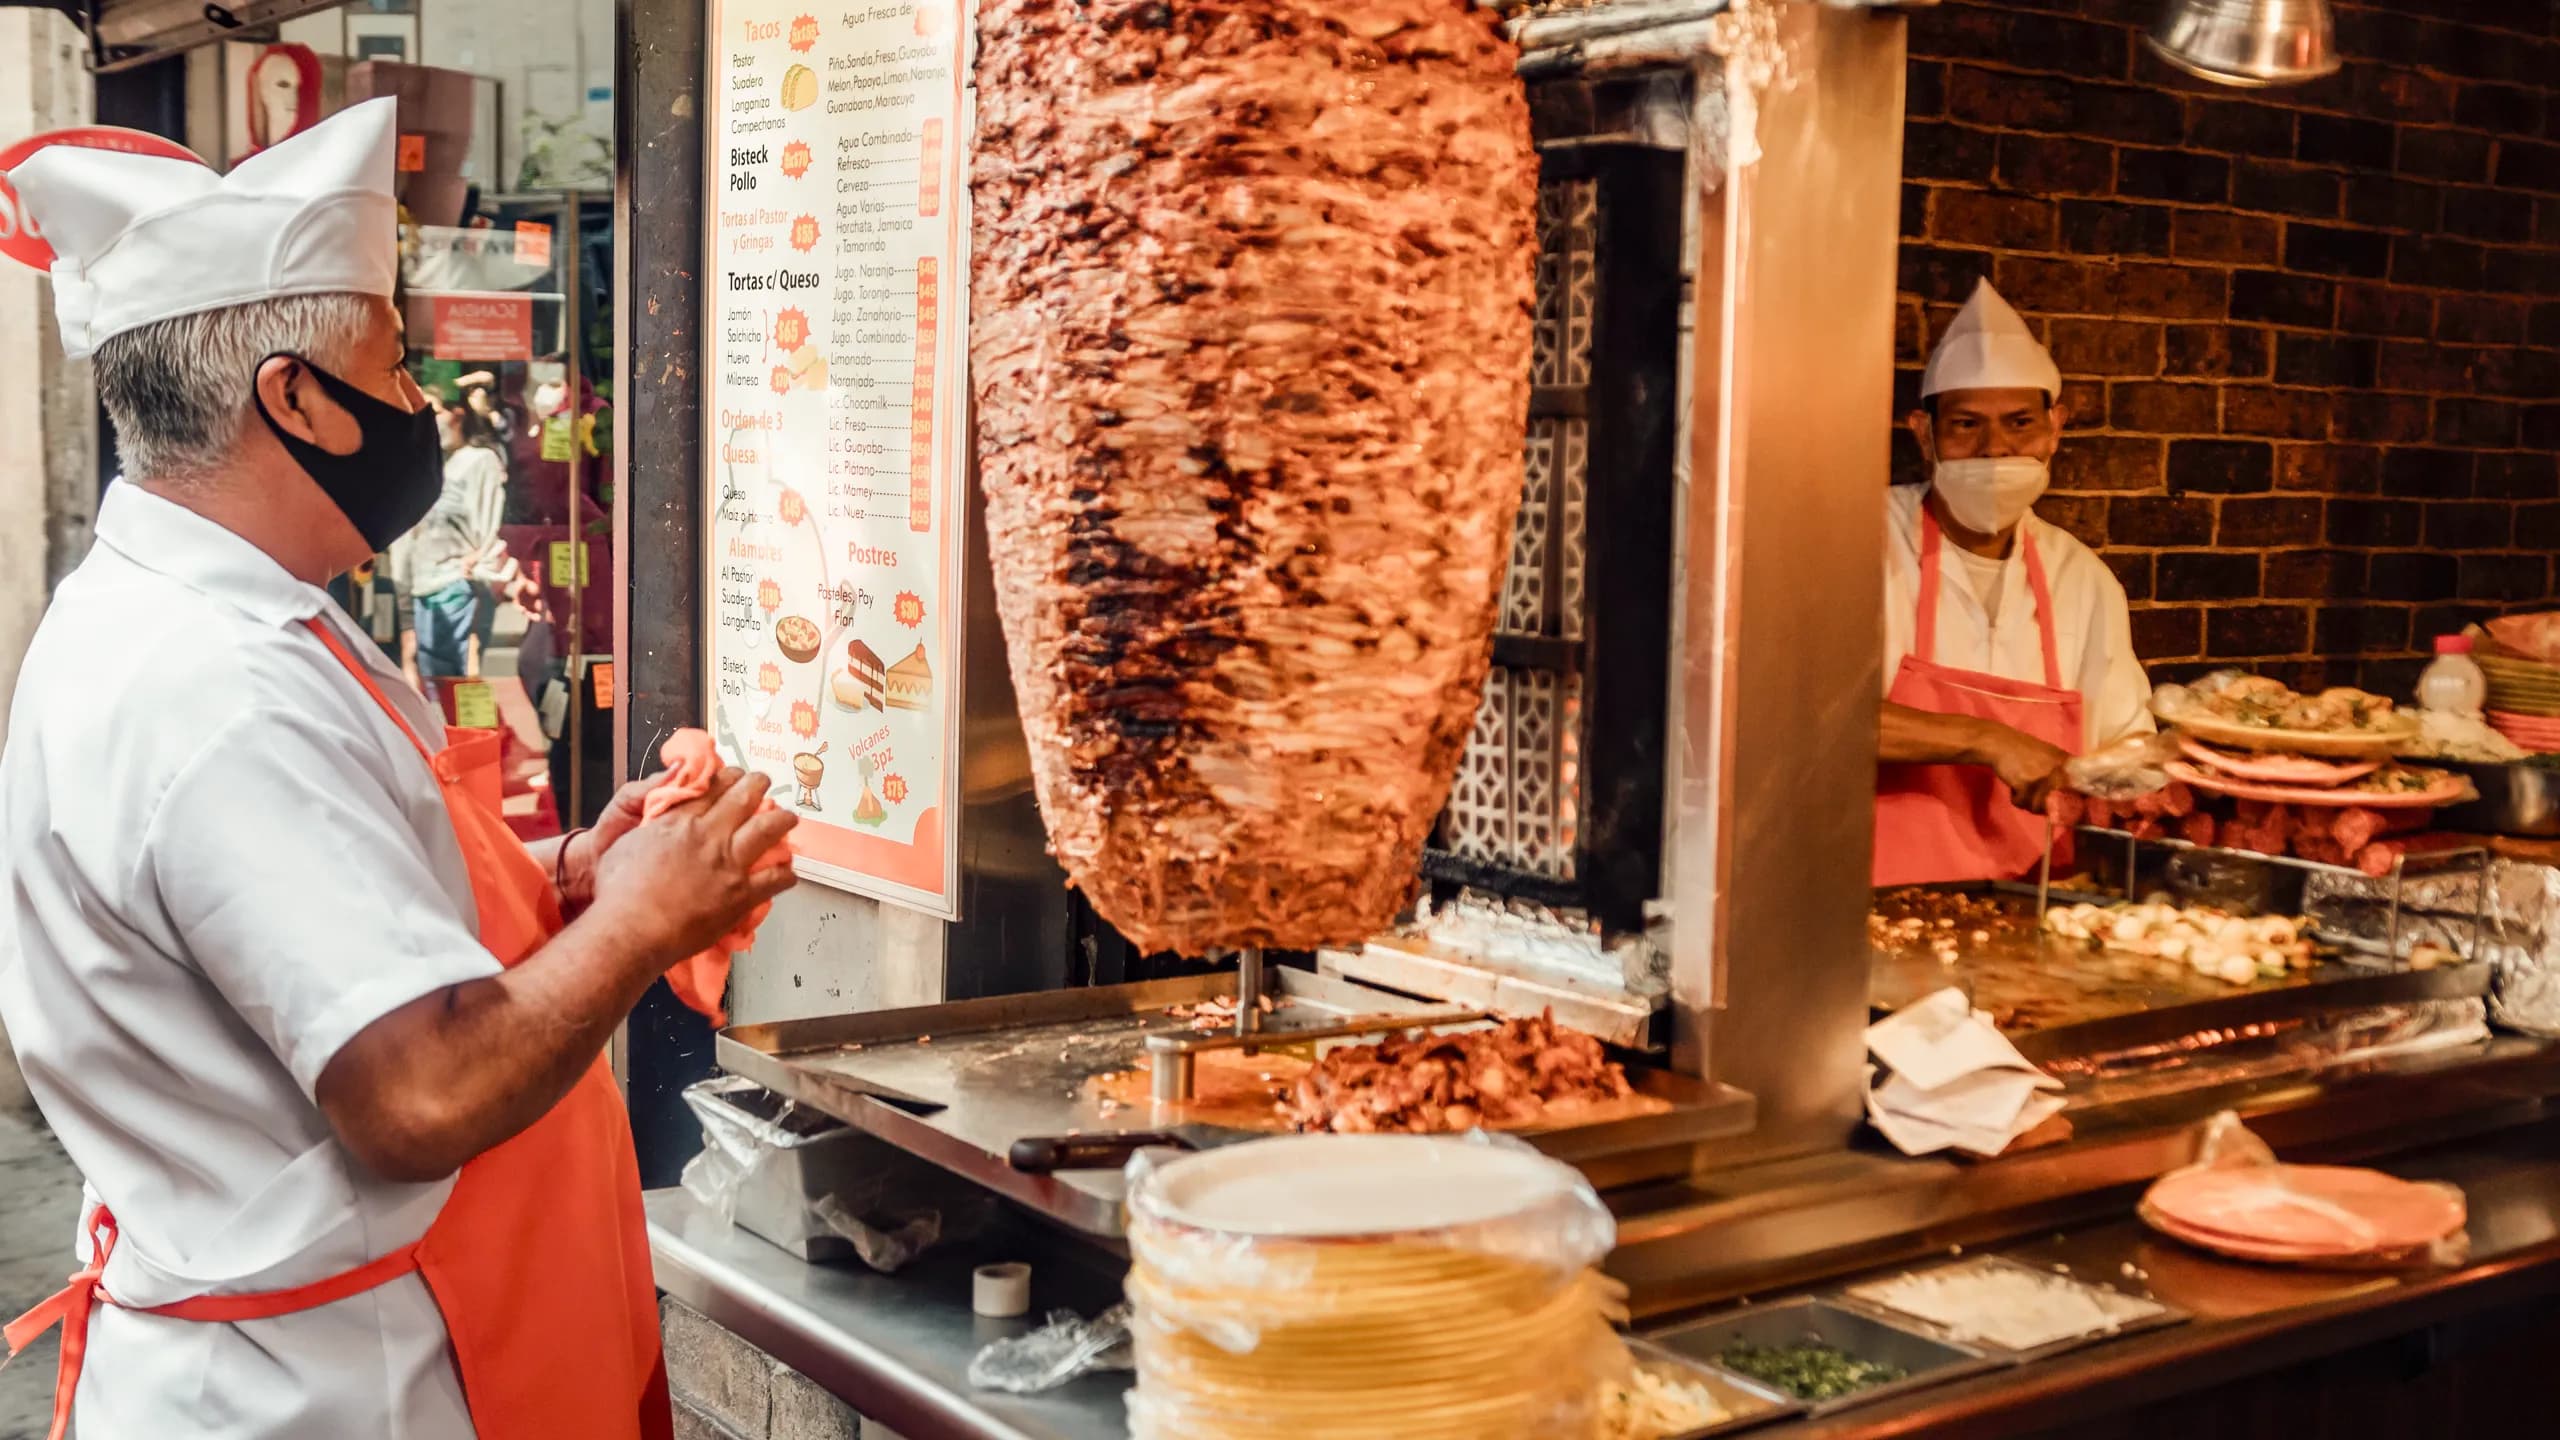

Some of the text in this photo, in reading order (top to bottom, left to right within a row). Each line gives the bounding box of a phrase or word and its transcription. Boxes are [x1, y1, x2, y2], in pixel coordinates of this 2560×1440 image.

[842, 12, 865, 28] Agua
[868, 7, 896, 21] Fresca
[745, 21, 780, 42] Tacos
[733, 54, 755, 68] Pastor
[732, 74, 763, 90] Suadero
[732, 94, 770, 114] Longaniza
[838, 136, 859, 152] Agua
[862, 128, 912, 146] Combinada
[731, 144, 768, 166] Bisteck
[838, 155, 870, 171] Refresco
[730, 171, 756, 191] Pollo
[837, 179, 868, 193] Cerveza
[836, 202, 857, 218] Agua
[860, 198, 885, 214] Varias
[722, 209, 787, 227] Tortas al Pastor
[877, 217, 912, 232] Jamaica
[733, 234, 774, 255] y Gringas
[843, 238, 885, 253] Tamarindo
[860, 263, 894, 279] Naranja
[728, 269, 819, 291] Tortas c/ Queso
[859, 285, 890, 301] Toranja
[857, 306, 901, 322] Zanahoria
[728, 329, 761, 342] Salchicha
[778, 320, 798, 344] $65
[728, 350, 749, 364] Huevo
[831, 352, 871, 365] Limonada
[727, 371, 758, 386] Milanesa
[831, 374, 874, 388] Naranjada
[722, 409, 783, 430] Orden de 3
[845, 417, 866, 431] Fresa
[845, 439, 882, 456] Guayaba
[723, 484, 745, 500] Queso
[844, 484, 873, 500] Mamey
[844, 504, 864, 519] Nuez
[849, 541, 897, 567] Postres
[722, 566, 753, 583] Al Pastor
[722, 588, 752, 607] Suadero
[859, 589, 874, 609] Pay
[722, 610, 760, 631] Longaniza
[835, 610, 854, 627] Flan
[723, 656, 747, 674] Bisteck
[723, 679, 740, 696] Pollo
[848, 724, 890, 761] Volcanes
[750, 741, 786, 763] Fundido
[872, 747, 893, 771] 3pz
